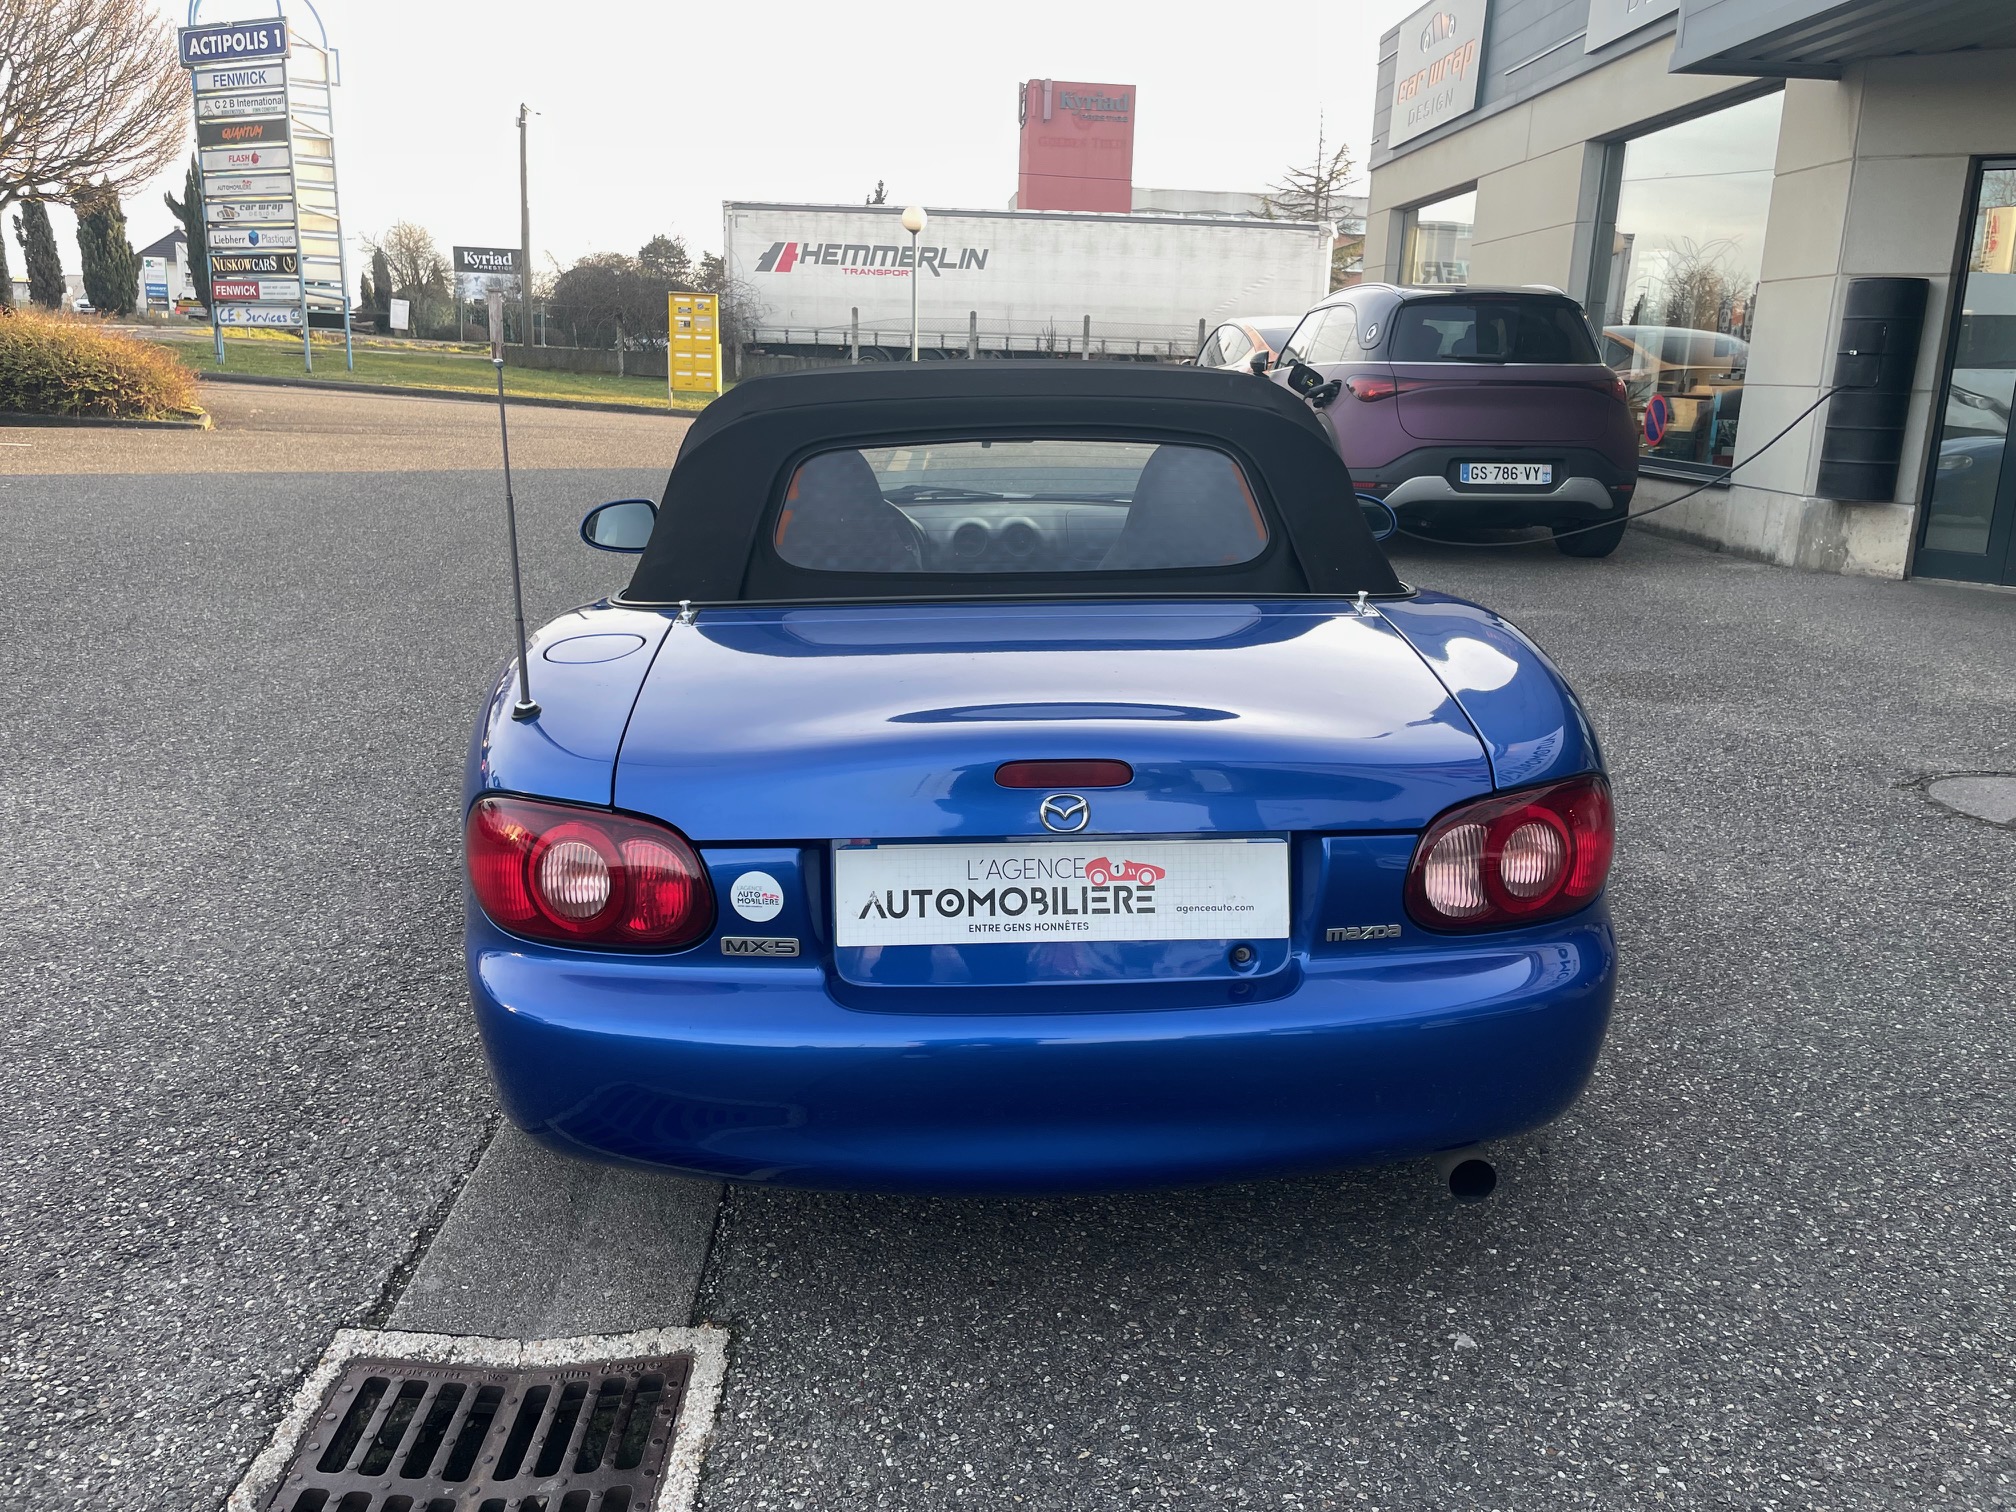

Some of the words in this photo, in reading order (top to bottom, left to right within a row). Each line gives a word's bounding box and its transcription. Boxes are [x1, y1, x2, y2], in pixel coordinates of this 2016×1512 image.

[189, 30, 269, 56] ACTIPOLIS
[274, 29, 281, 48] 1
[212, 70, 267, 88] FENWICK
[1397, 68, 1426, 105] car
[1427, 38, 1475, 89] wrap
[214, 100, 221, 110] C
[222, 99, 227, 109] 2
[229, 99, 235, 108] B
[236, 95, 284, 108] International
[1060, 90, 1129, 116] Kyriad
[1408, 87, 1454, 127] DESIGN
[221, 124, 264, 140] QUANTUM
[228, 154, 250, 163] FLASH
[239, 203, 256, 211] car
[258, 203, 284, 213] wrap
[213, 234, 246, 245] Liebherr
[261, 233, 293, 246] Plastique
[463, 251, 513, 269] Kyriad
[799, 242, 990, 277] HEMMERLIN
[842, 267, 914, 277] TRANSPOR
[215, 285, 257, 296] FENWICK
[245, 308, 288, 323] Services
[1470, 466, 1541, 481] GS-786-VY
[967, 857, 1087, 881] L'AGENCE
[1176, 903, 1255, 915] agenceauto.com
[968, 924, 1001, 933] ENTRE
[1003, 923, 1032, 932] GENS
[1034, 920, 1090, 931] HONNÊTES
[725, 940, 796, 954] MX-5
